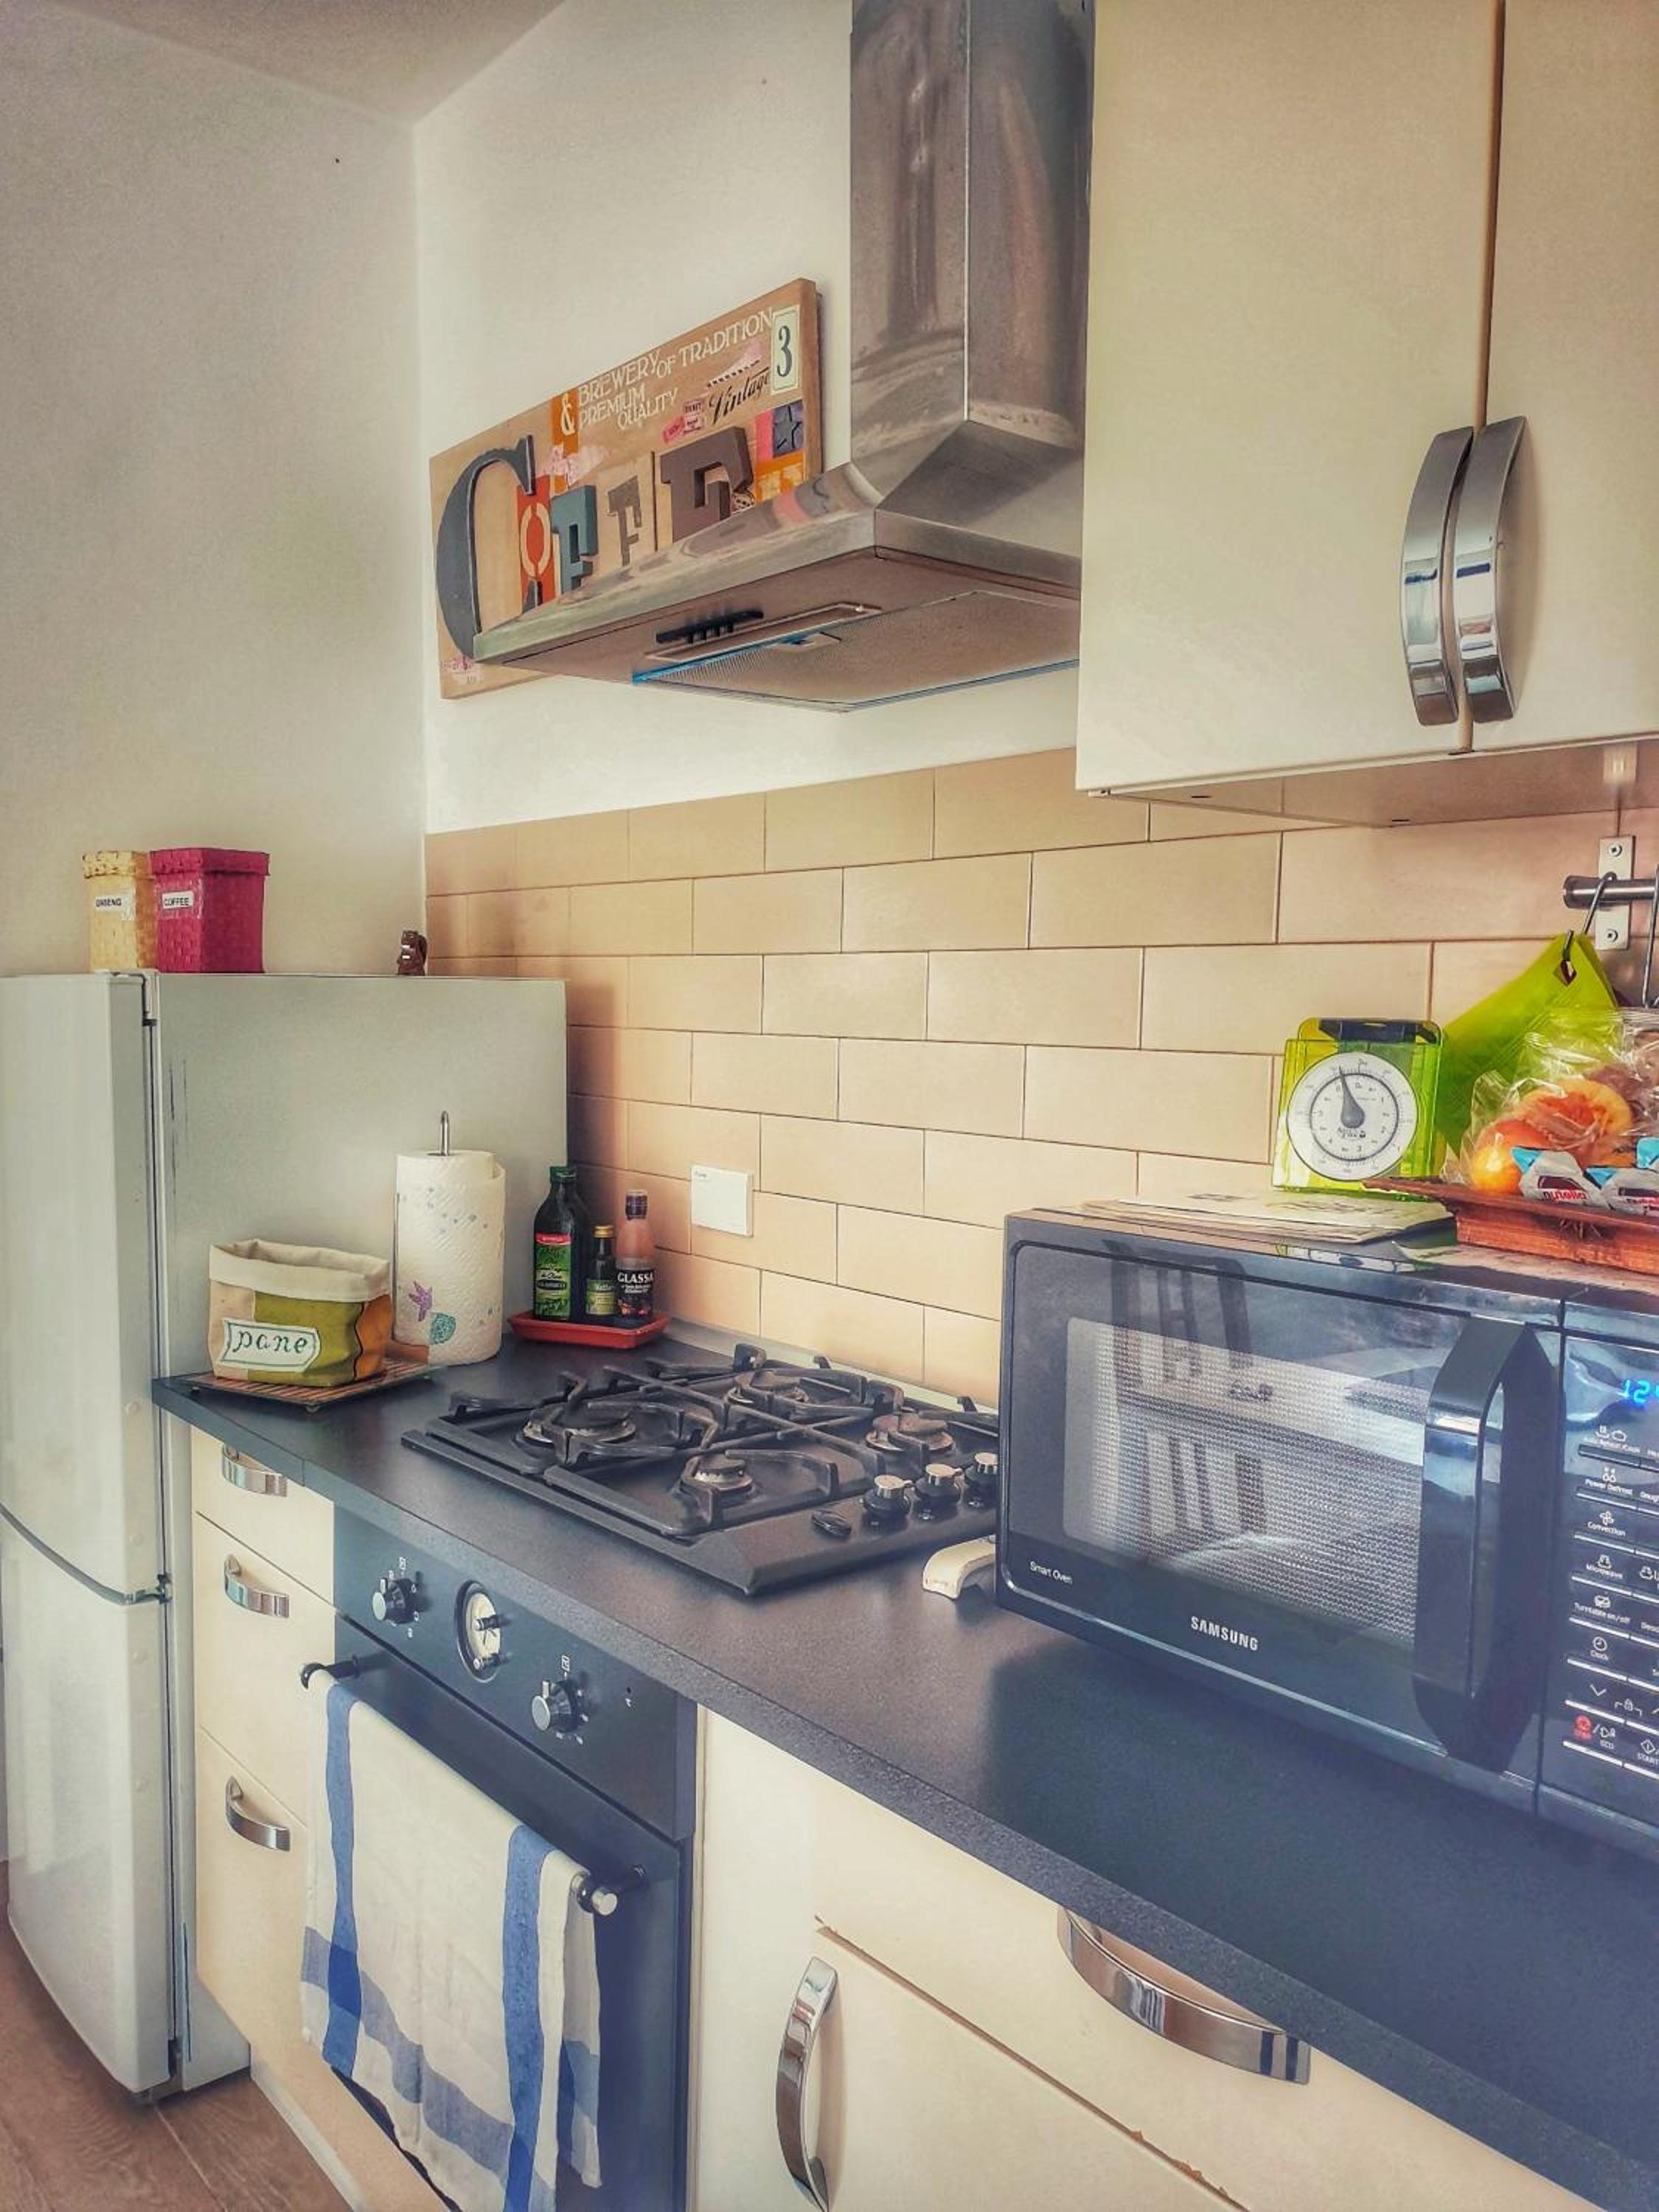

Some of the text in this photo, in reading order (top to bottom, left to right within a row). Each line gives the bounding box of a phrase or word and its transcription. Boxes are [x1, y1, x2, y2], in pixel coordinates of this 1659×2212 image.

[579, 306, 773, 406] BREWERY OF TRADITION
[776, 324, 793, 378] 3
[579, 382, 646, 429] PREMIUM
[617, 387, 678, 431] QUALITY
[709, 366, 770, 425] Vintage
[164, 897, 189, 907] COFFEE
[232, 1330, 308, 1354] pane
[1587, 1521, 1627, 1537] Convection
[1030, 1560, 1073, 1585] Smart Oven
[1191, 1615, 1259, 1651] SAMSUNG
